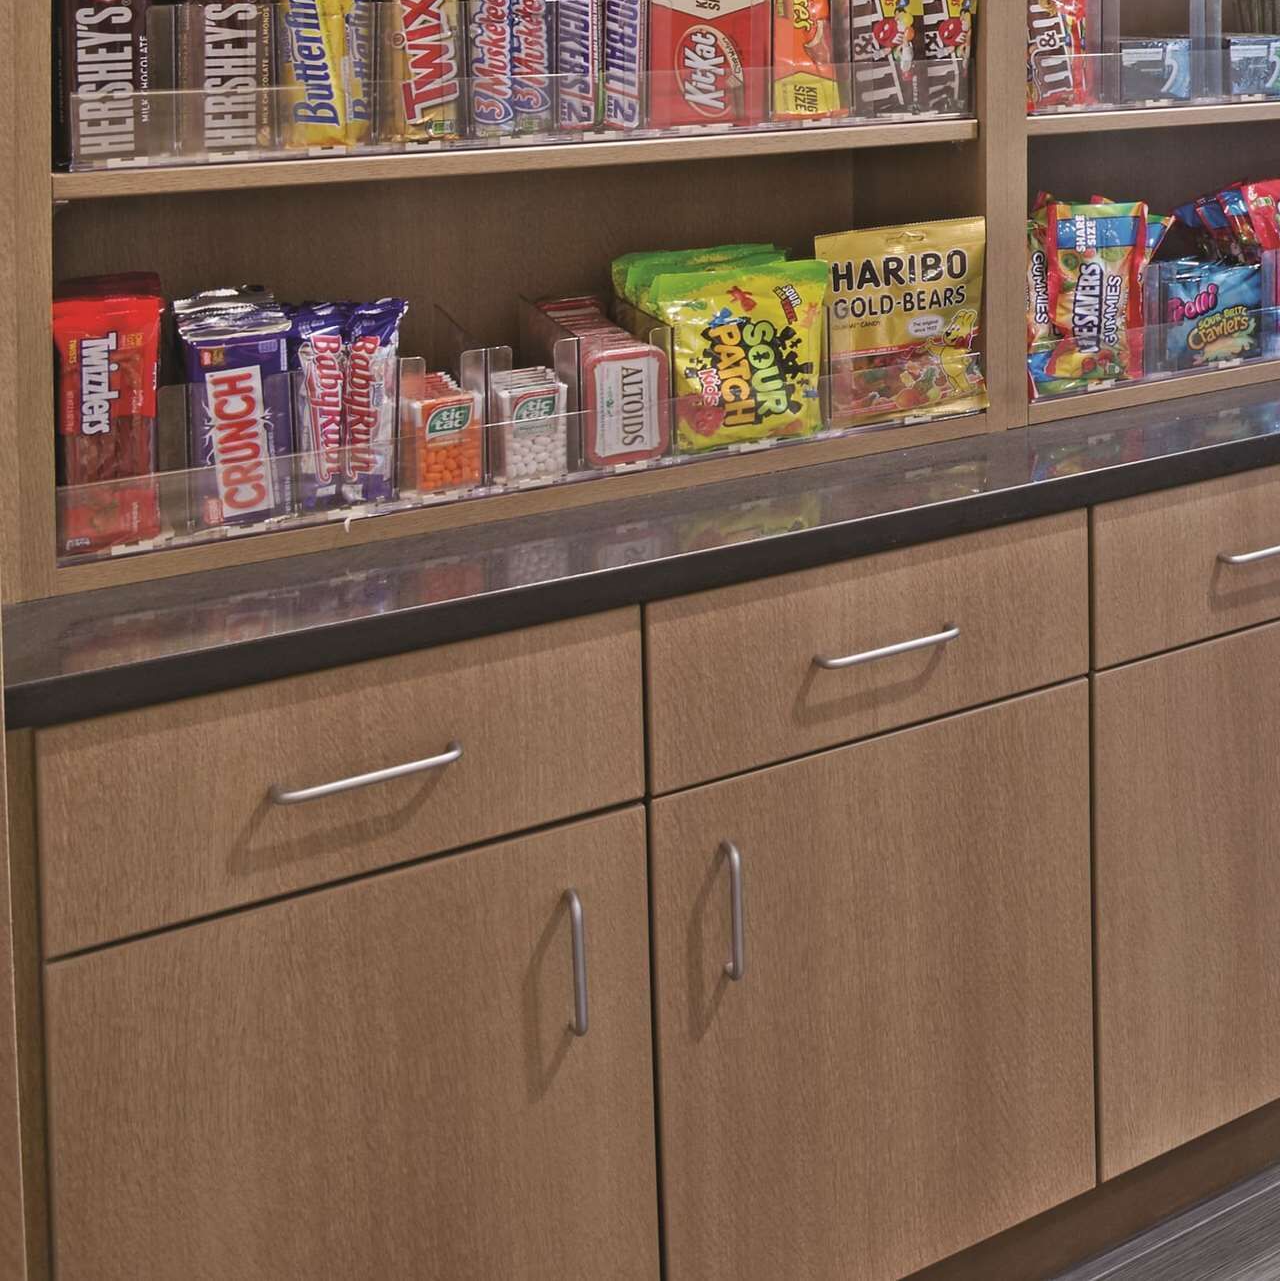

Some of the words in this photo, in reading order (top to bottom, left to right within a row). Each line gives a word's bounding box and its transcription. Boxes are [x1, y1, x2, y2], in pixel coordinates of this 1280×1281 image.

[76, 6, 135, 154] HERSHEY'S
[204, 4, 257, 147] HERSHEY'S
[141, 92, 151, 123] MILK
[794, 85, 806, 112] SIZE
[806, 87, 817, 112] KING
[1075, 215, 1086, 252] SHARE
[1087, 220, 1097, 246] SIZE
[832, 250, 967, 292] HARIBO
[1032, 250, 1049, 324] GUMMIES
[834, 286, 966, 319] GOLD-BEARS
[1104, 275, 1122, 346] GUMMIES
[1188, 314, 1248, 349] Crawlers
[81, 332, 118, 436] Twizzlers
[711, 324, 756, 426] PATCH
[744, 320, 788, 416] SOUR
[435, 419, 460, 430] tac
[442, 409, 463, 420] tic
[528, 399, 547, 412] tic
[621, 367, 645, 445] ALTOIDS
[213, 371, 267, 511] CRUNCH
